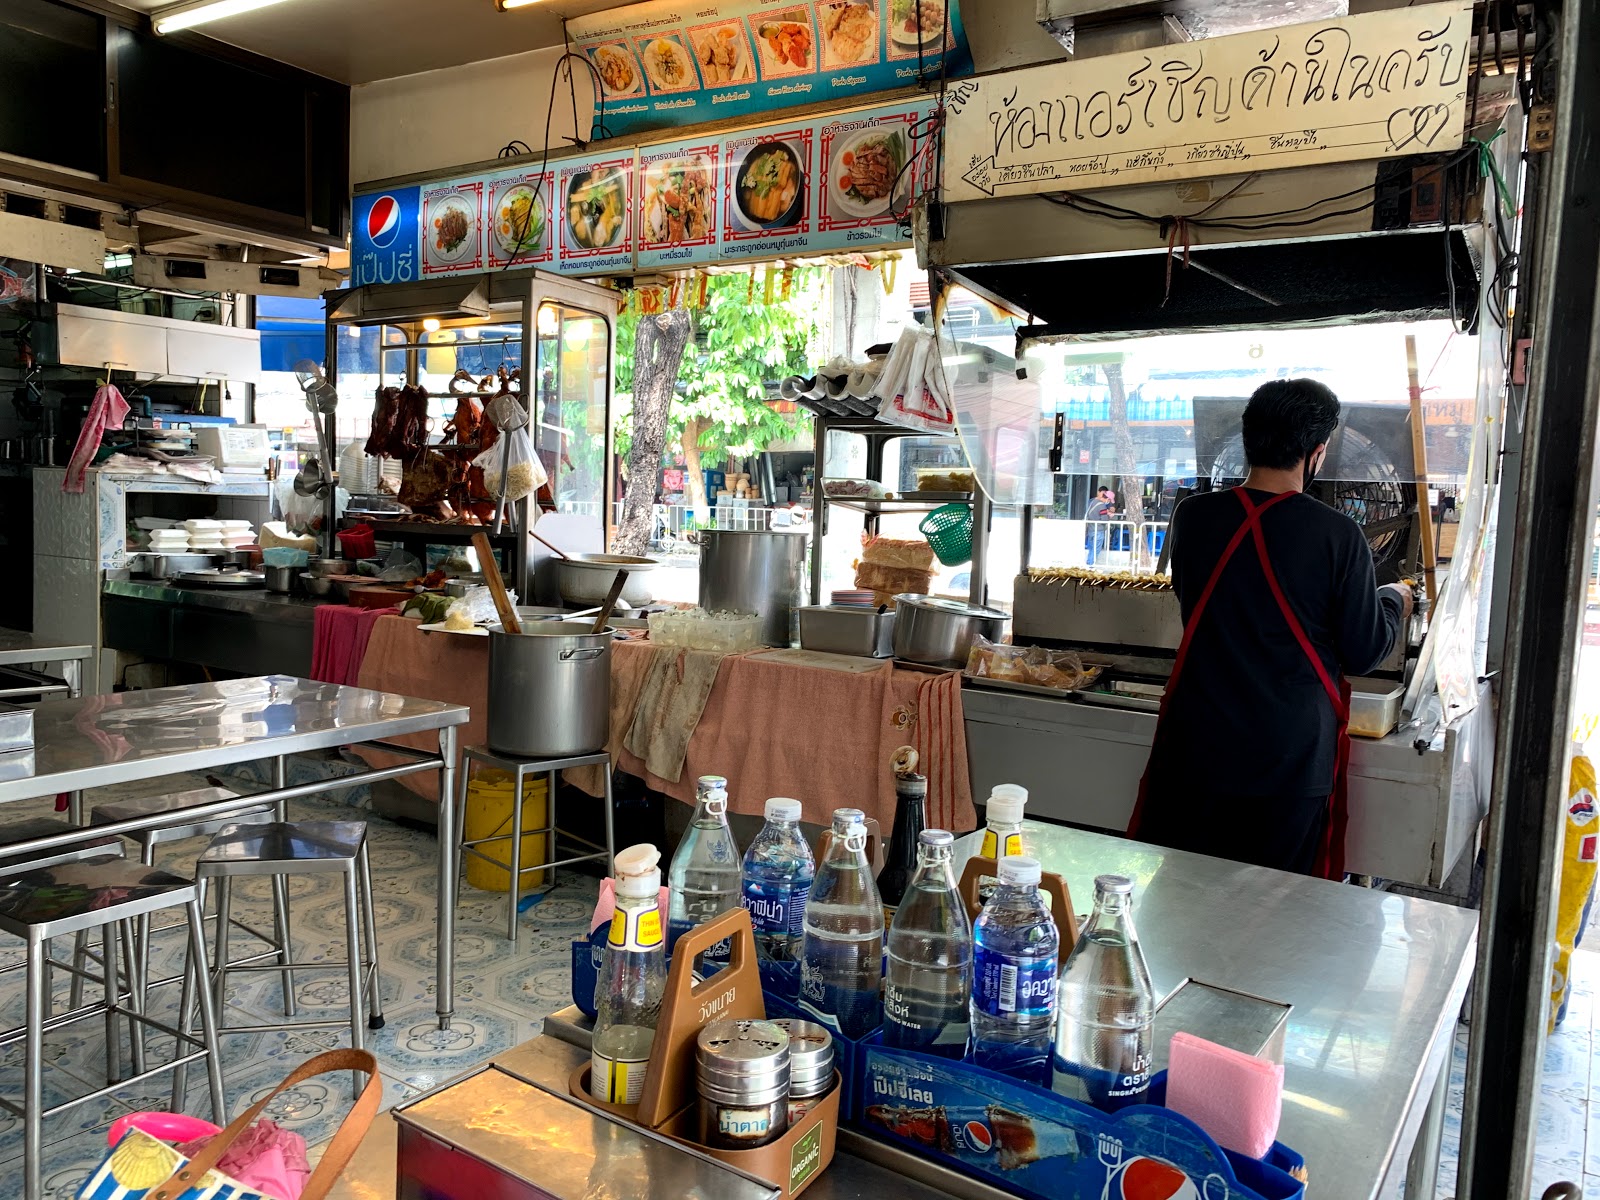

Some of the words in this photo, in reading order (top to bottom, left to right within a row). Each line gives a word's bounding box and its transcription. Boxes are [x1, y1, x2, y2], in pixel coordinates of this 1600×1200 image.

[823, 118, 881, 136] อาหารจานเด็ด
[641, 147, 689, 164] อาหารจานเด็ด
[356, 243, 412, 287] เป๊ปซี่
[902, 1018, 922, 1030] WATER
